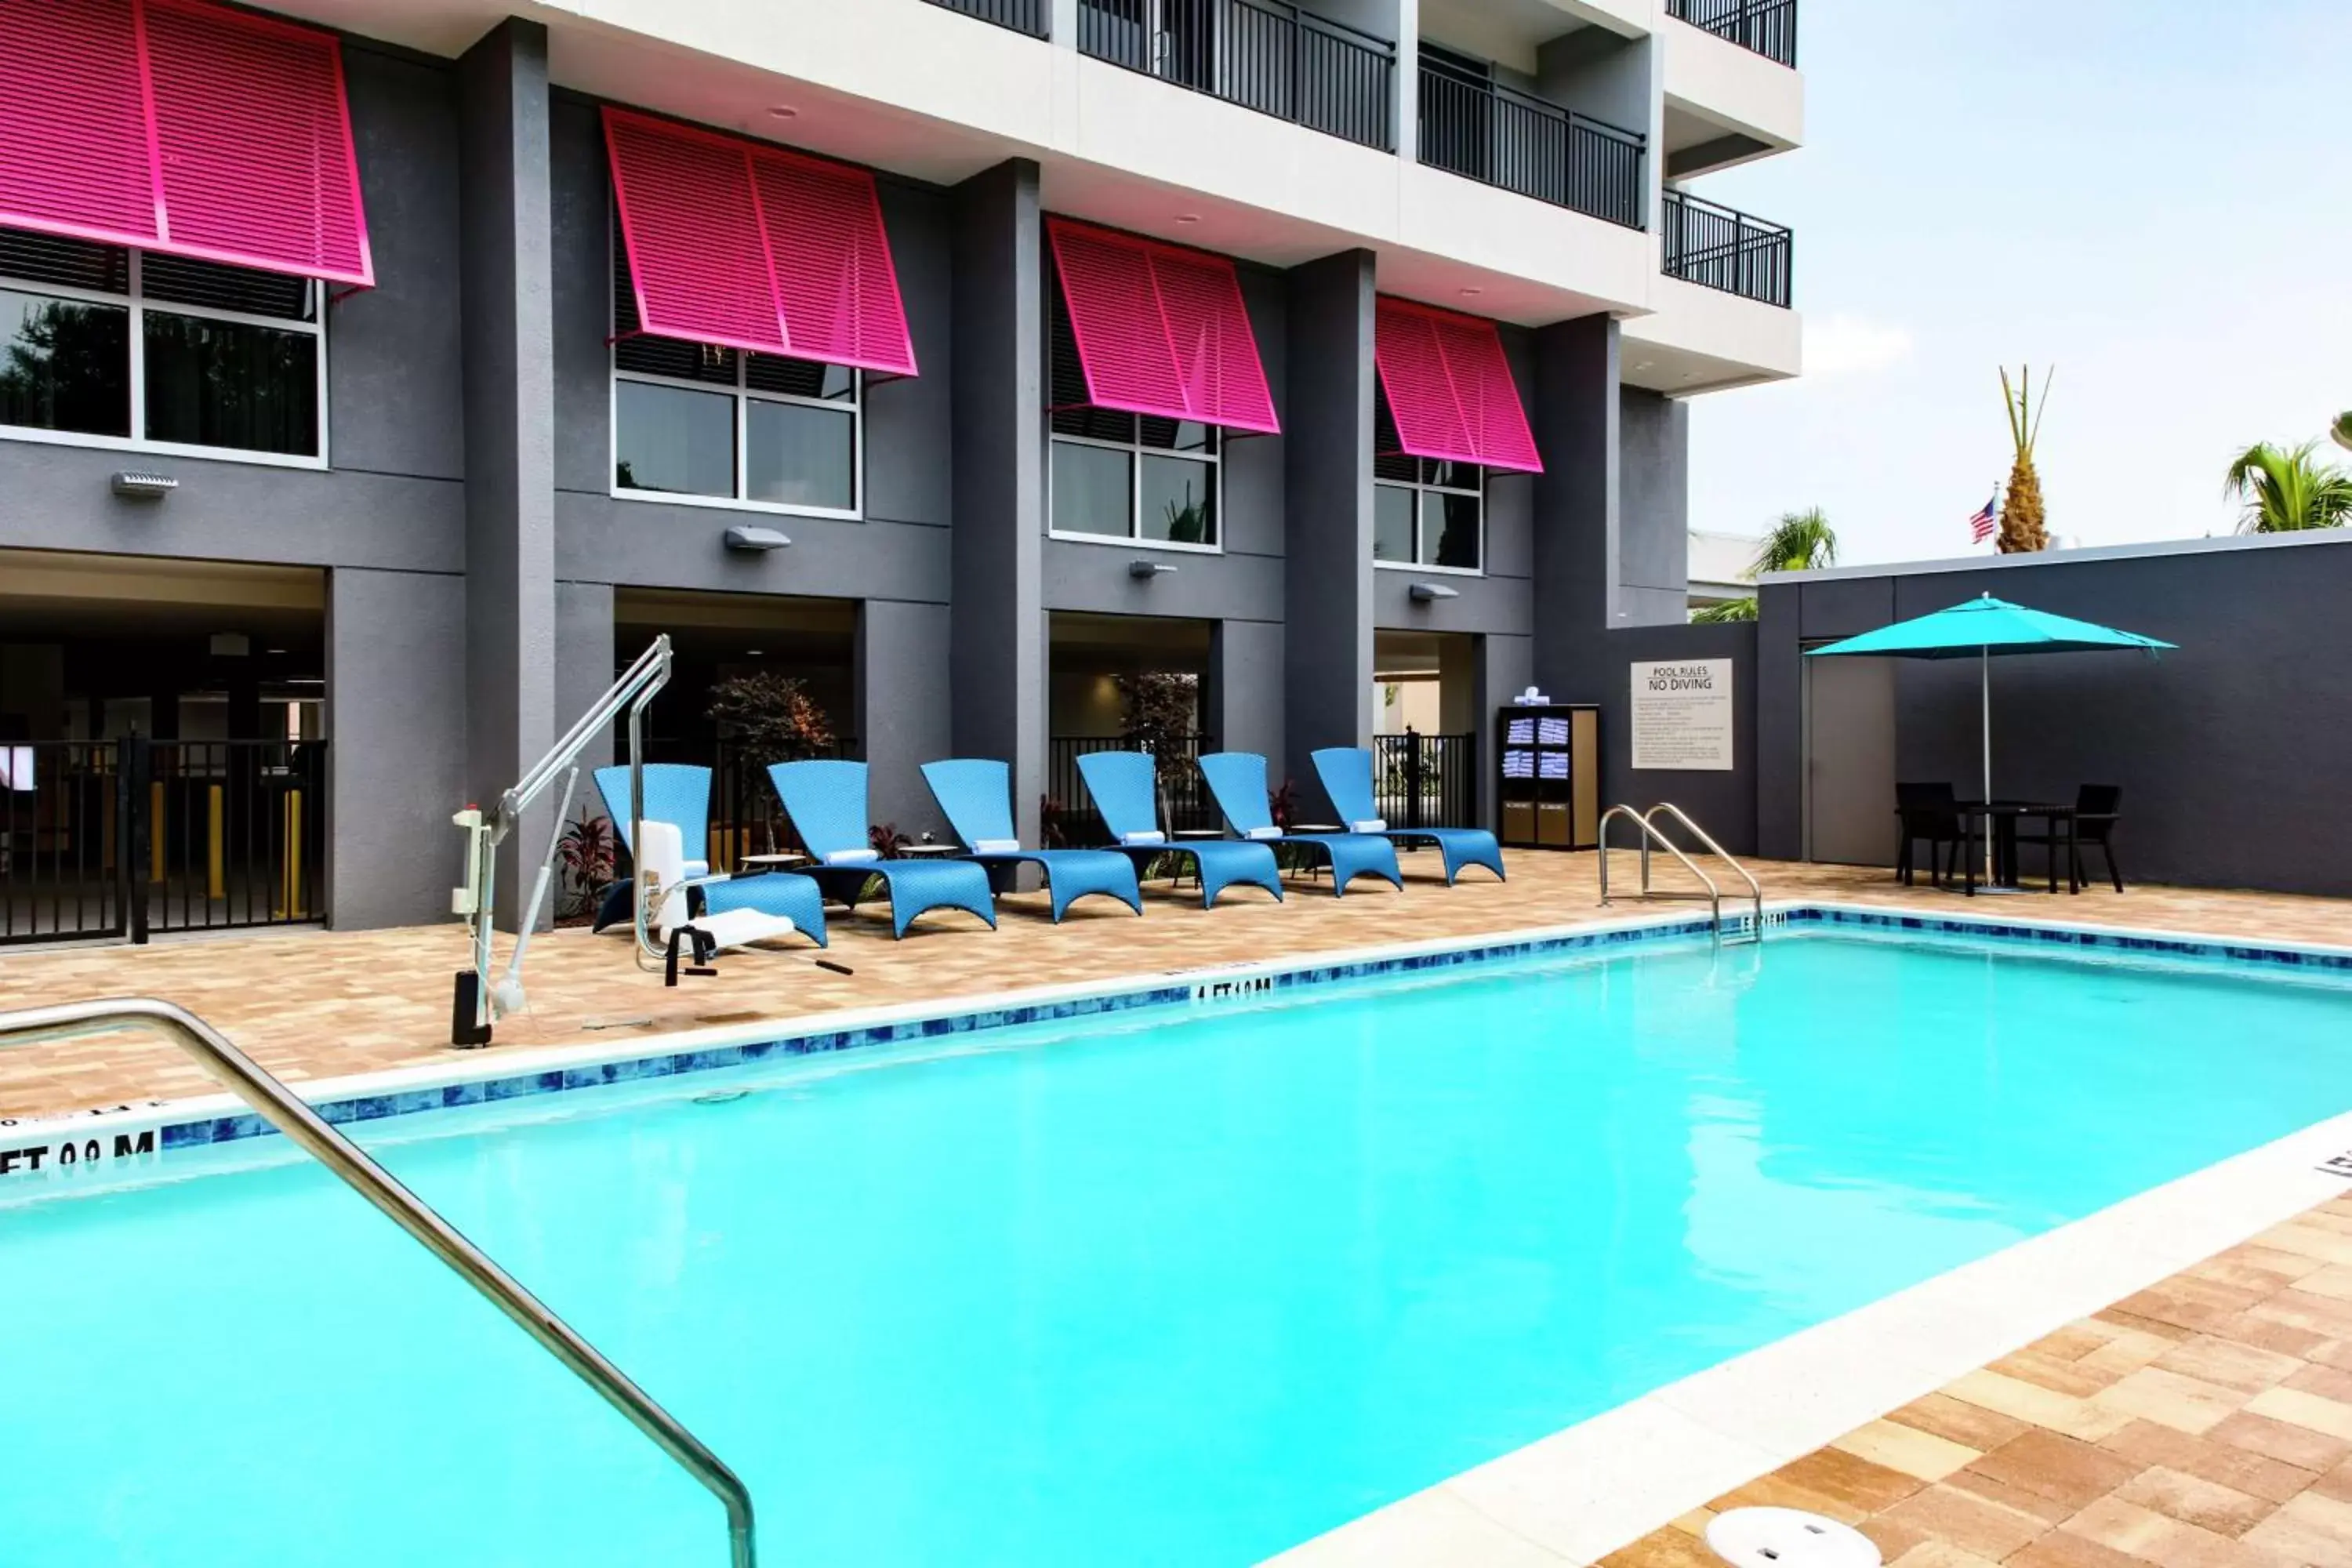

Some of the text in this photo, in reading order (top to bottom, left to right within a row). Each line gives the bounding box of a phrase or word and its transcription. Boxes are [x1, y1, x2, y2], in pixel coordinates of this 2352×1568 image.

[1653, 666, 1708, 677] POOL RULES
[1649, 678, 1712, 691] NO DIVING
[114, 1131, 154, 1158] M
